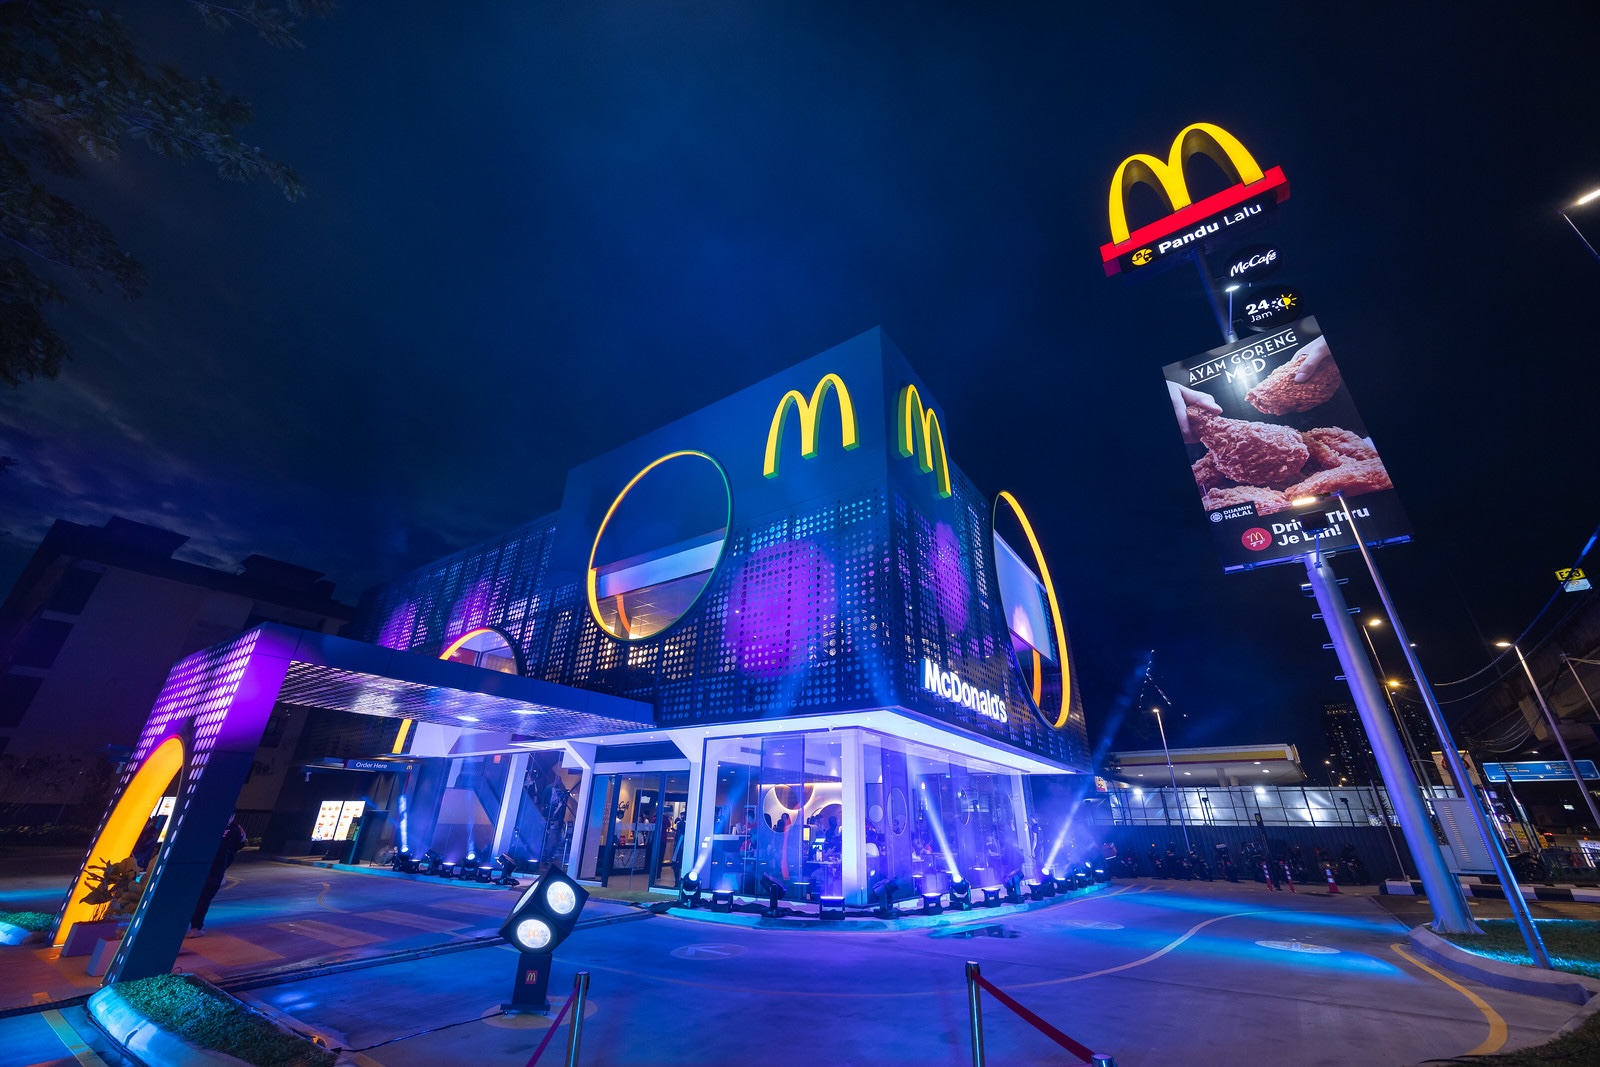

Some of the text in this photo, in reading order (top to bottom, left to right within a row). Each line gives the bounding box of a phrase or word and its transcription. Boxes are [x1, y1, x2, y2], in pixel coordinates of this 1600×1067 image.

[1158, 203, 1262, 254] Pandu Lalu
[1230, 249, 1277, 277] McCafé
[1245, 299, 1270, 315] 24
[1250, 311, 1273, 323] Jam
[1189, 331, 1297, 383] AYAM GORENG
[1224, 509, 1254, 520] HALAL
[1271, 507, 1371, 535] Dri Thru
[1277, 534, 1300, 546] Je
[922, 658, 1008, 723] McDonald's
[355, 761, 373, 769] Order
